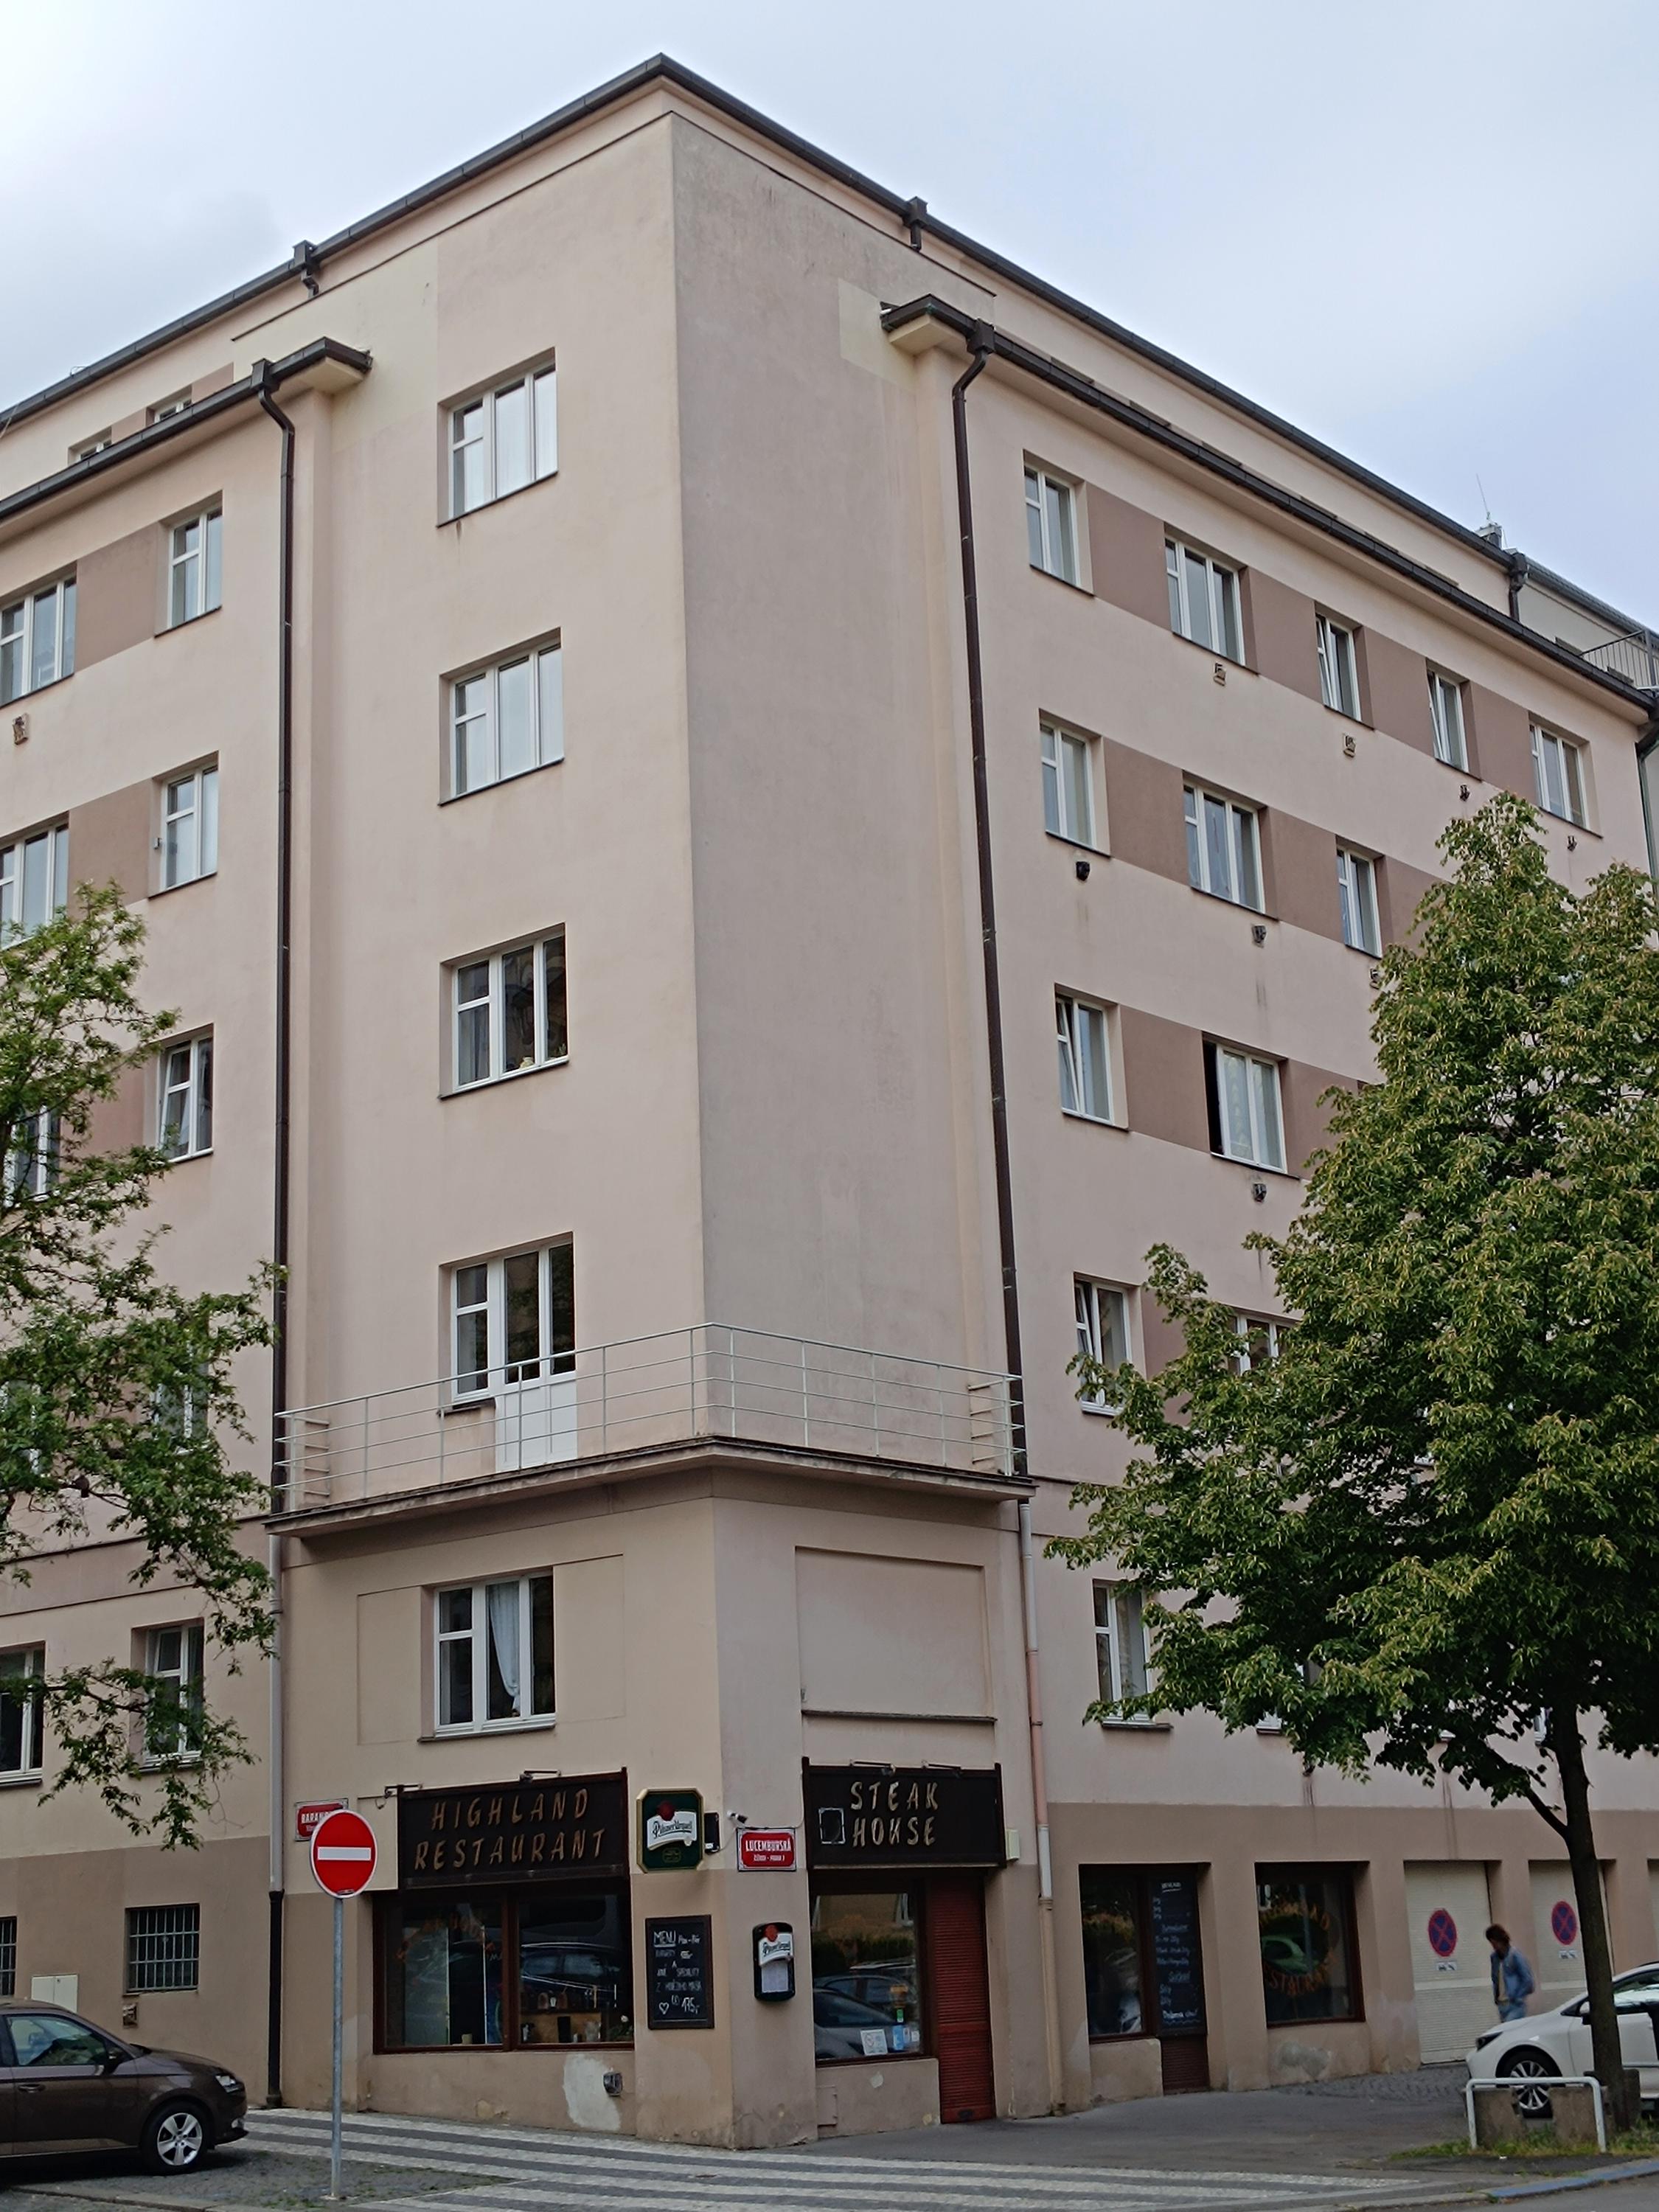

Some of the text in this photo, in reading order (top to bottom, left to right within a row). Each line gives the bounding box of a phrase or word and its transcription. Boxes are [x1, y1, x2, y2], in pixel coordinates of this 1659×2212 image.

[431, 1787, 588, 1830] HIGHLAND
[850, 1781, 938, 1811] STEAK
[414, 1828, 606, 1871] RESTAURANT
